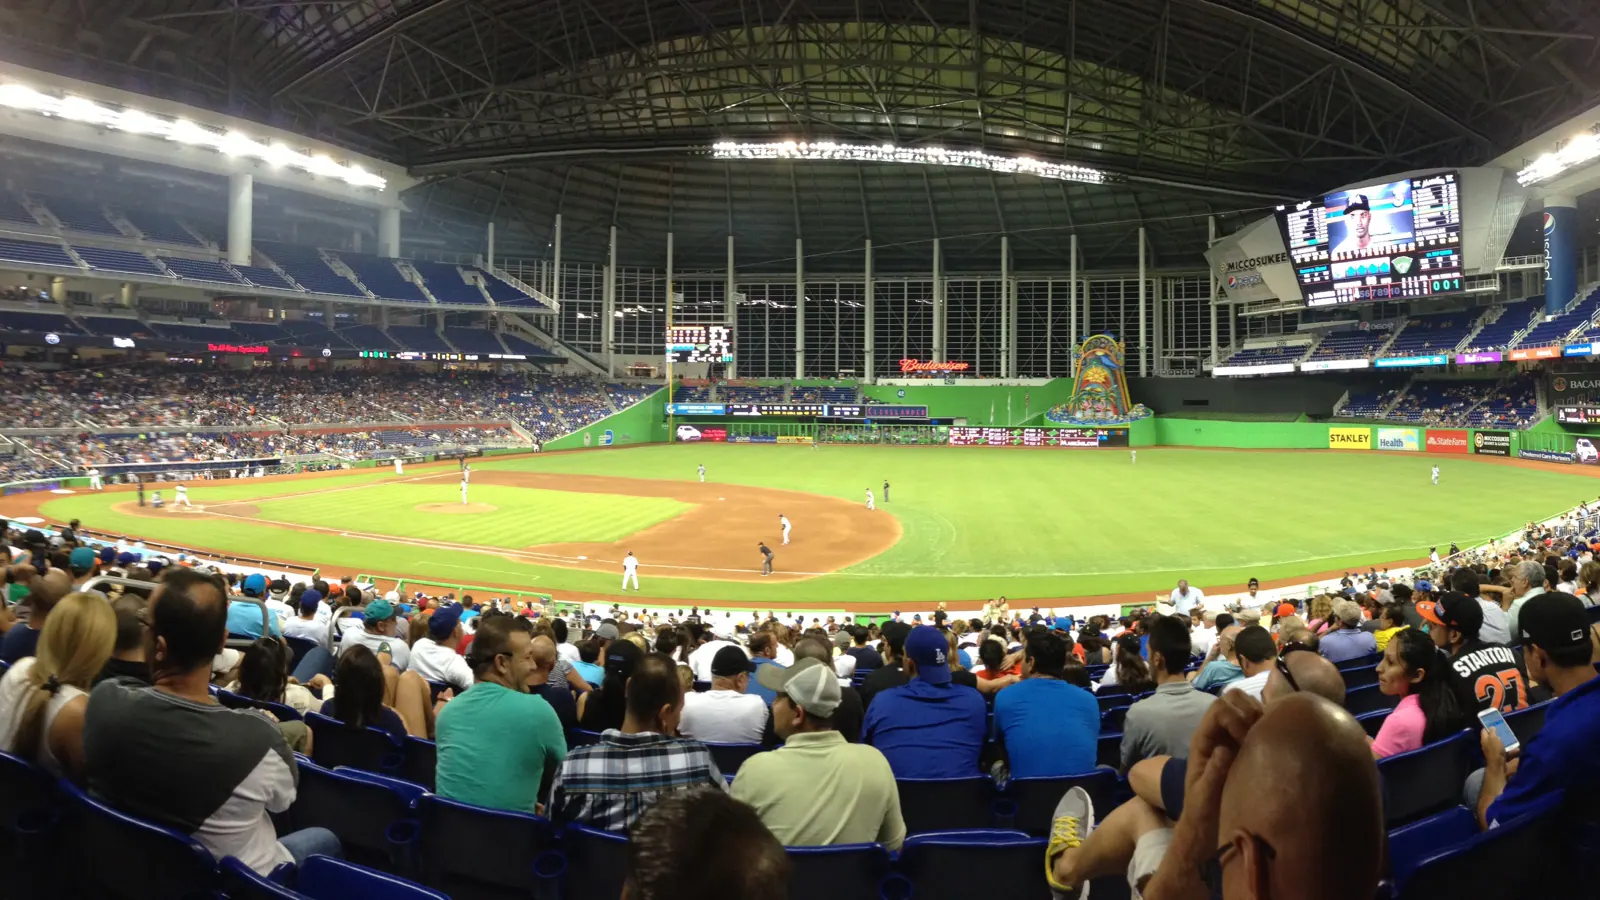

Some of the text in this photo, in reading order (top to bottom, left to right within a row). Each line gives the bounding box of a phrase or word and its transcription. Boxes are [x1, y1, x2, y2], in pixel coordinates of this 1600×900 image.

[1228, 253, 1287, 270] MICCOSUKEE
[899, 359, 968, 371] Budweiser
[1330, 434, 1369, 443] STANLEY
[1380, 438, 1404, 448] Health
[936, 648, 945, 664] LA
[1452, 646, 1516, 678] STANTON
[1474, 668, 1529, 713] 27
